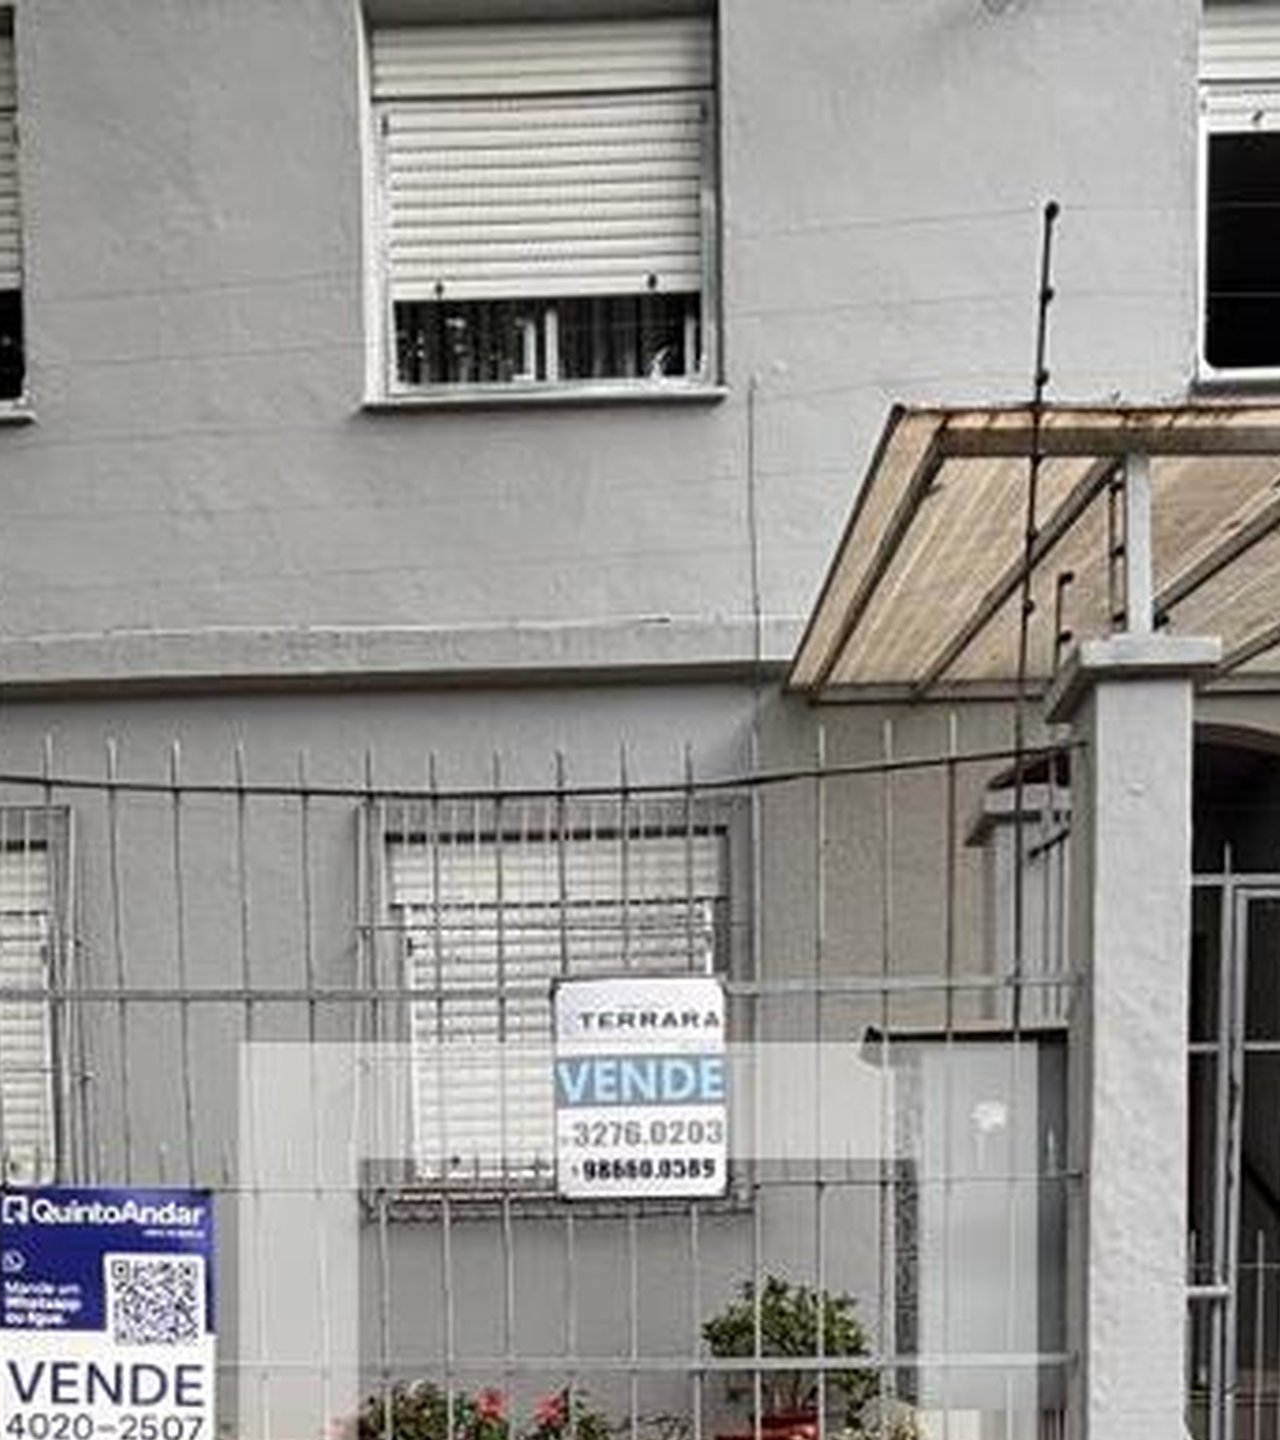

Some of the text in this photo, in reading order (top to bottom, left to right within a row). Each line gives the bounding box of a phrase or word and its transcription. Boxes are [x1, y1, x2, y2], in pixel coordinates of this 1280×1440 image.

[579, 1011, 720, 1029] TERRARA
[557, 1058, 724, 1103] VENDE
[573, 1120, 724, 1147] 3276.0203
[31, 1198, 206, 1226] QuintoAndar
[6, 1360, 206, 1407] VENDE
